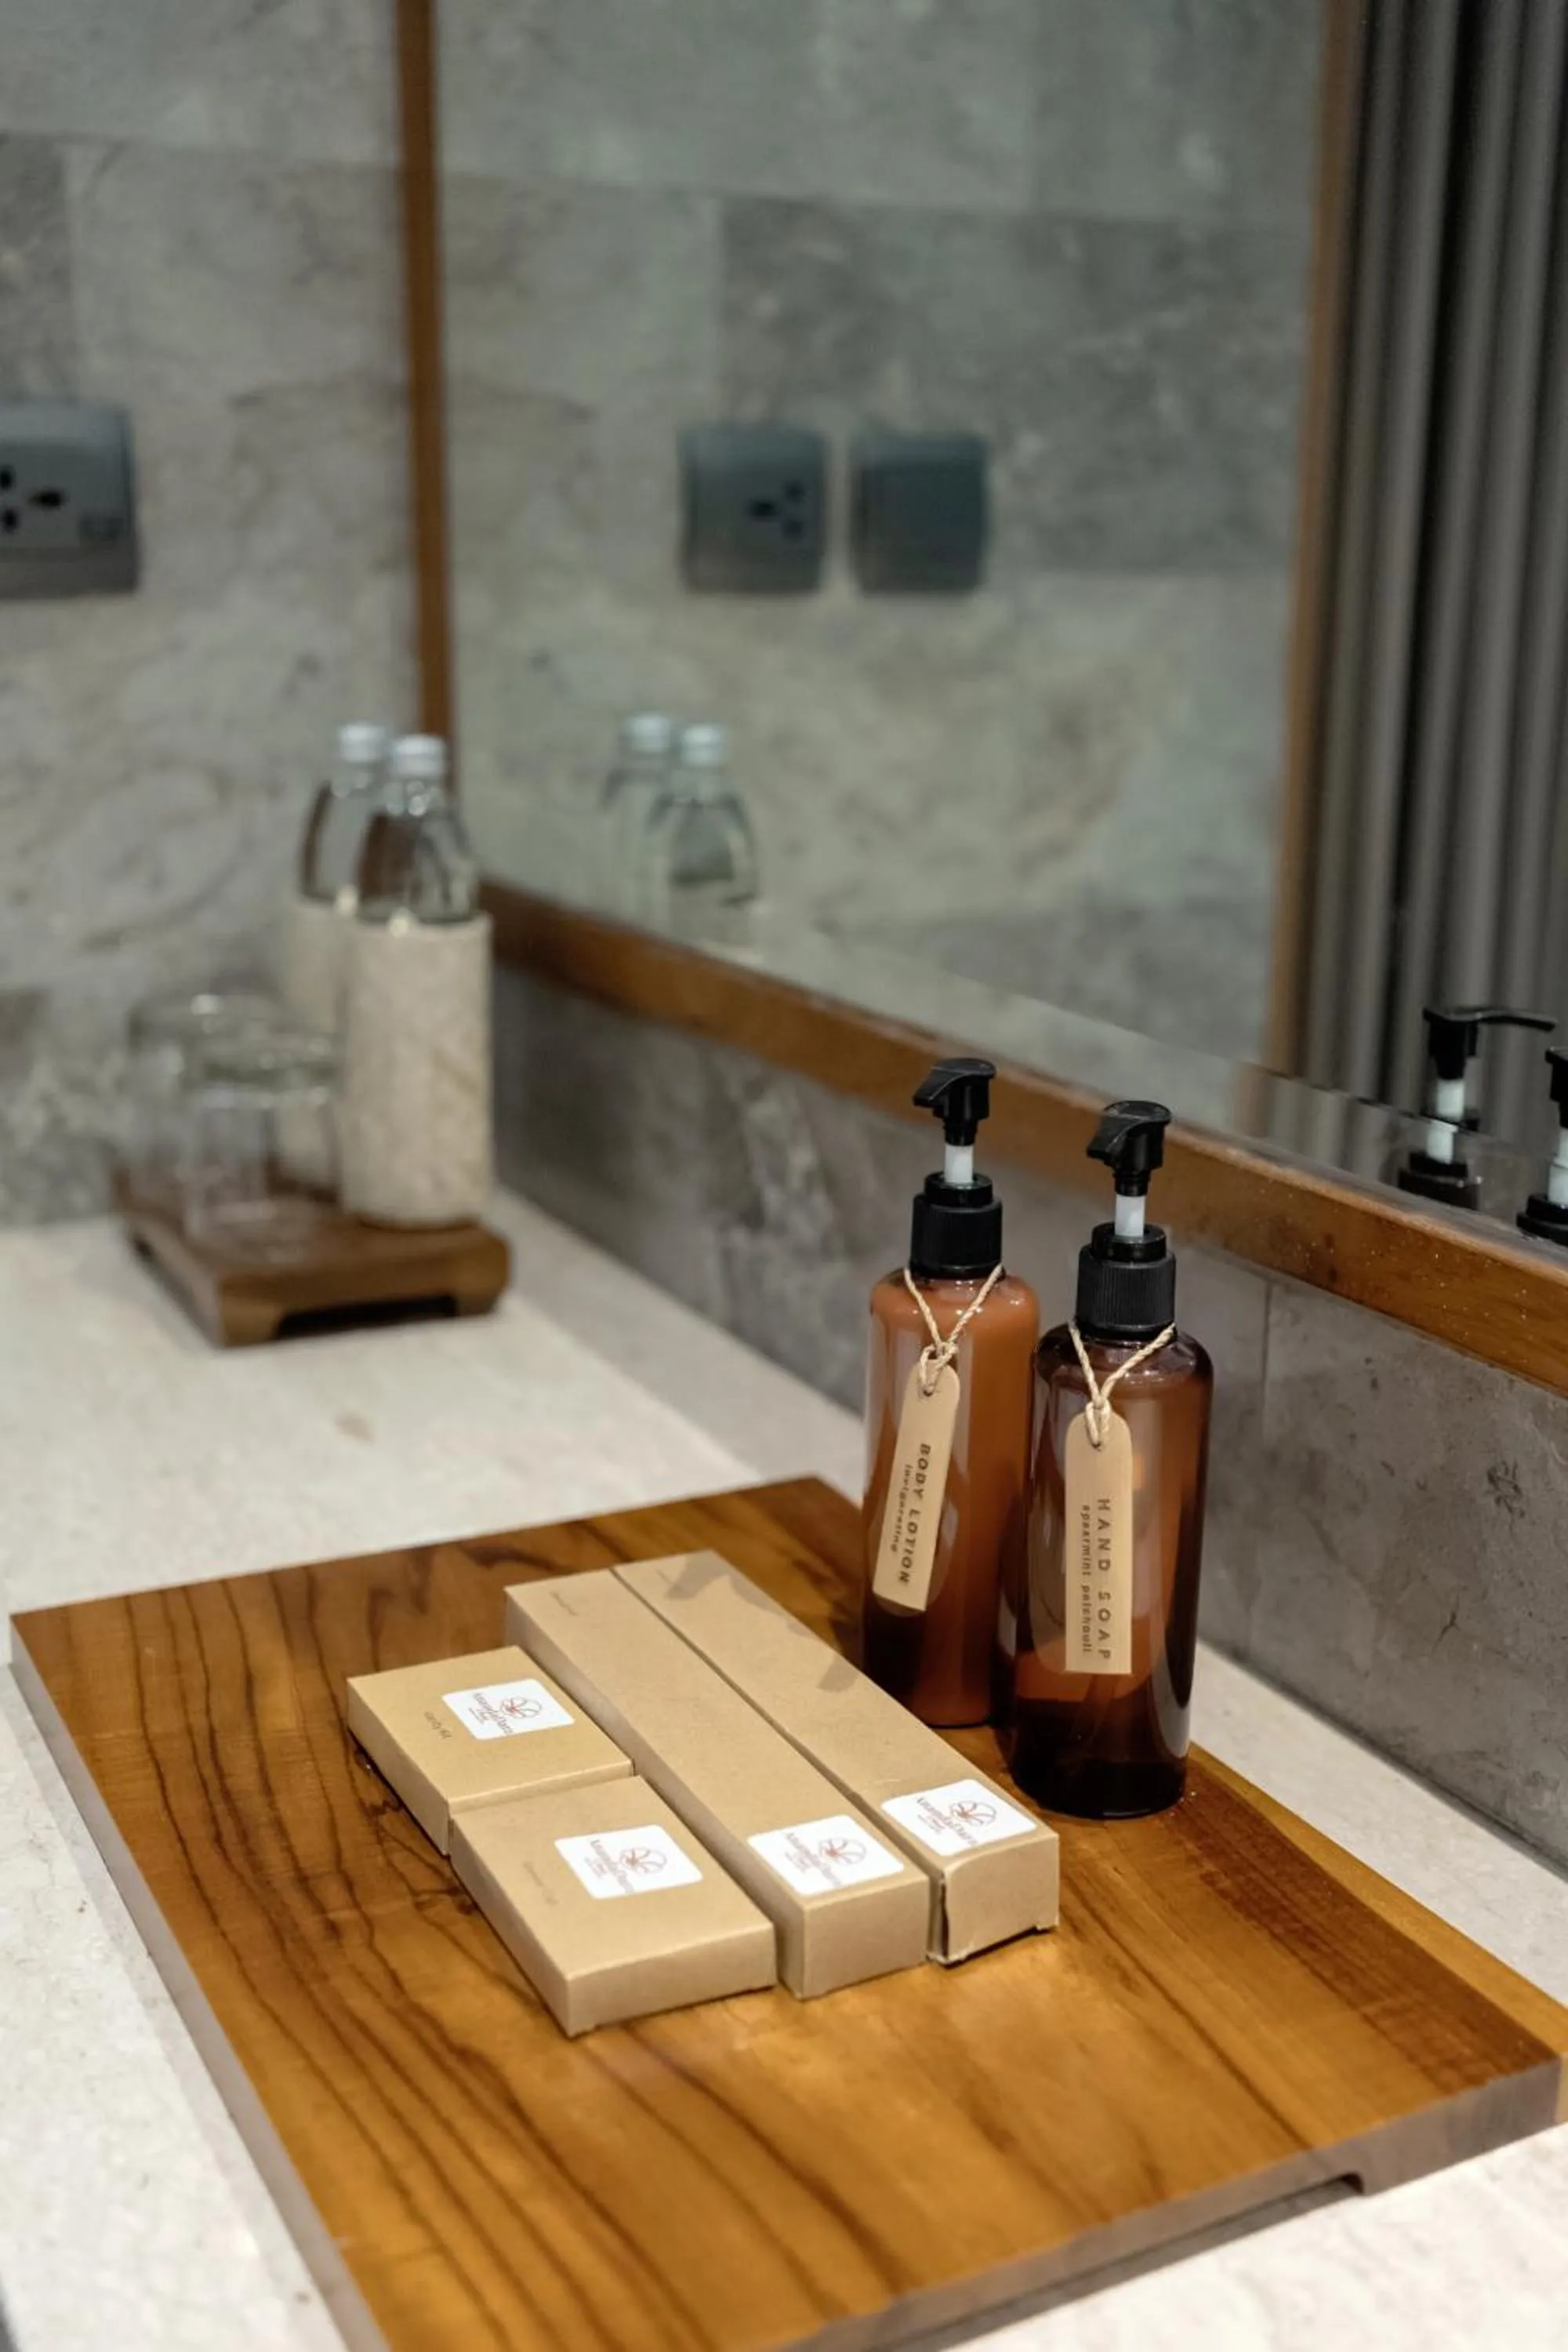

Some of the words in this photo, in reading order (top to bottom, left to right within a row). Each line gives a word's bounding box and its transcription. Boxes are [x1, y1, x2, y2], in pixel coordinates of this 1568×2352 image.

[913, 1443, 931, 1500] BODY
[899, 1508, 921, 1584] LOTION
[1080, 1504, 1092, 1576] spearmint
[1098, 1499, 1110, 1571] HAND
[1080, 1584, 1092, 1652] patchouli
[1098, 1592, 1111, 1660] SOAP
